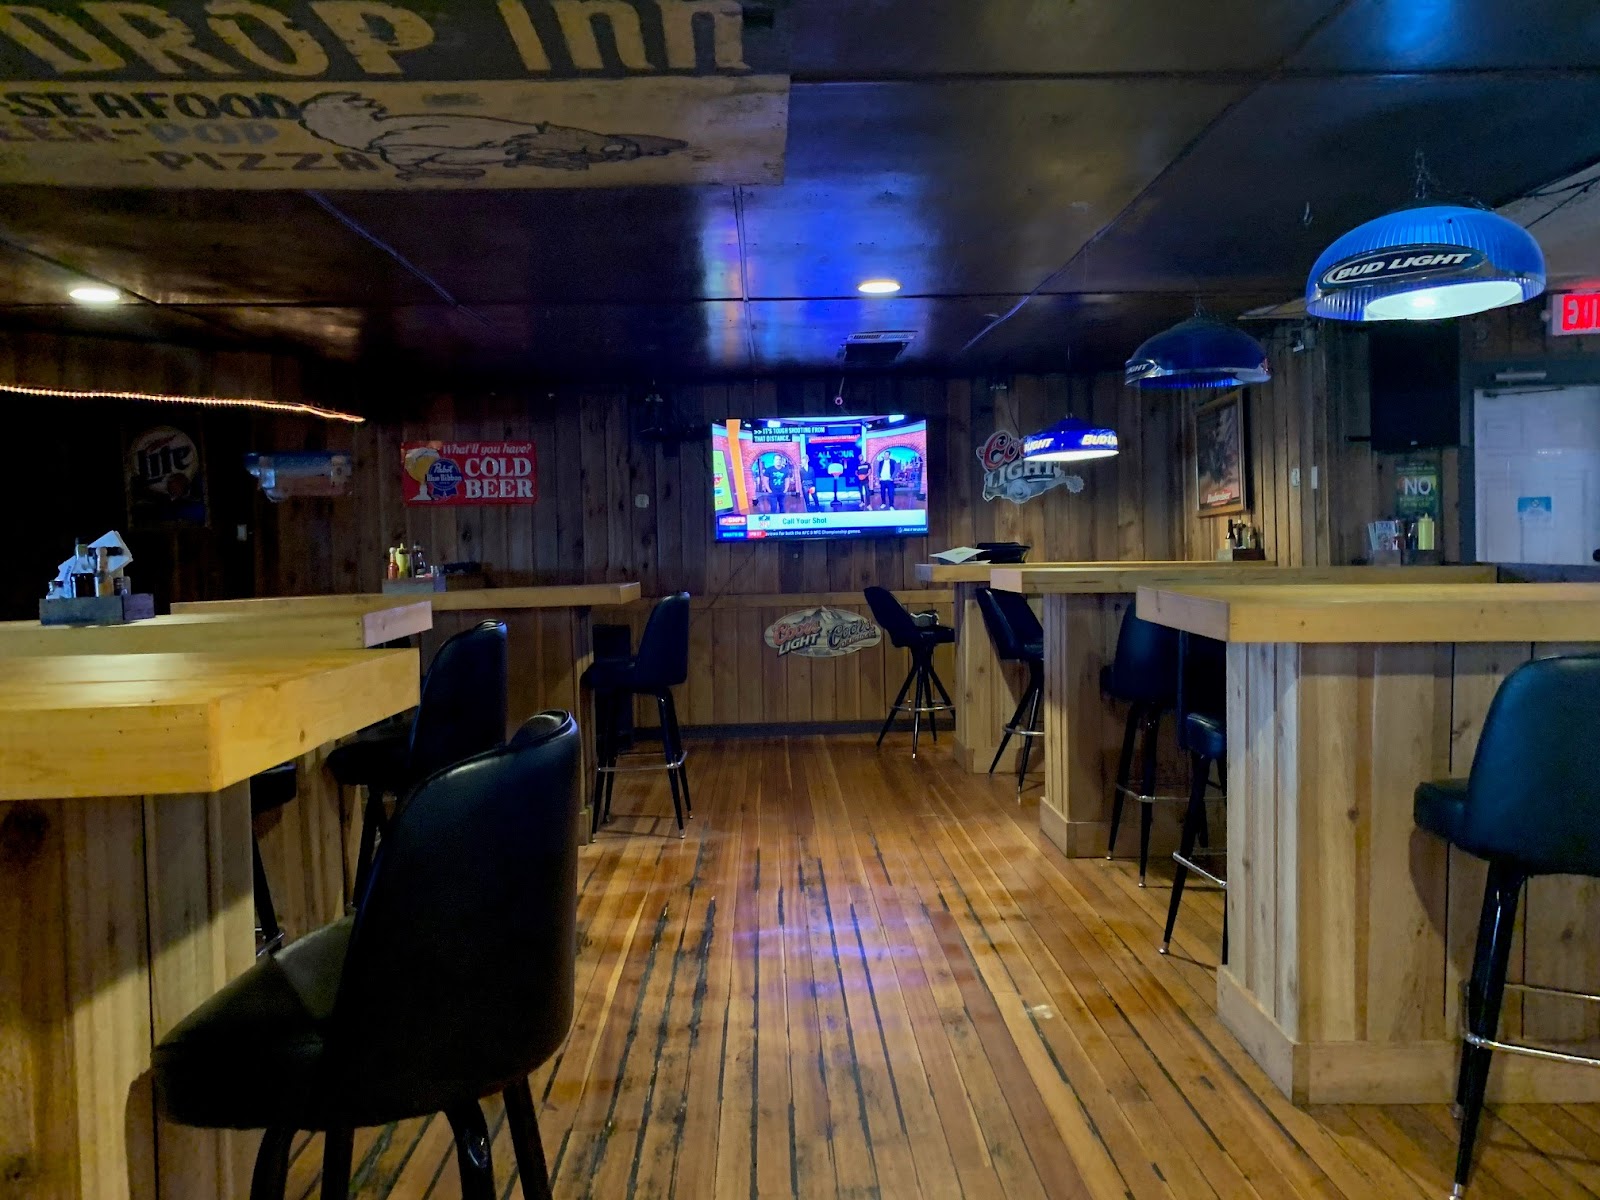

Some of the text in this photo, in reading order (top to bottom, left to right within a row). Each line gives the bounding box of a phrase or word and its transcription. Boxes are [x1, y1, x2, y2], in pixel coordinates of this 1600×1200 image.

[0, 0, 750, 77] DROP Inn
[3, 91, 303, 120] SEAFOOD
[1335, 252, 1472, 280] BUD LIGHT
[442, 442, 532, 456] What'll you have?
[1081, 434, 1108, 446] BUD
[432, 462, 454, 474] Pabst
[440, 473, 463, 481] Ribbon
[464, 457, 532, 477] COLD
[986, 459, 1056, 488] LIGHT
[465, 478, 534, 499] BEER
[1404, 477, 1432, 496] NO
[782, 517, 795, 525] Call
[796, 517, 811, 525] Your
[778, 633, 820, 656] LIGHT
